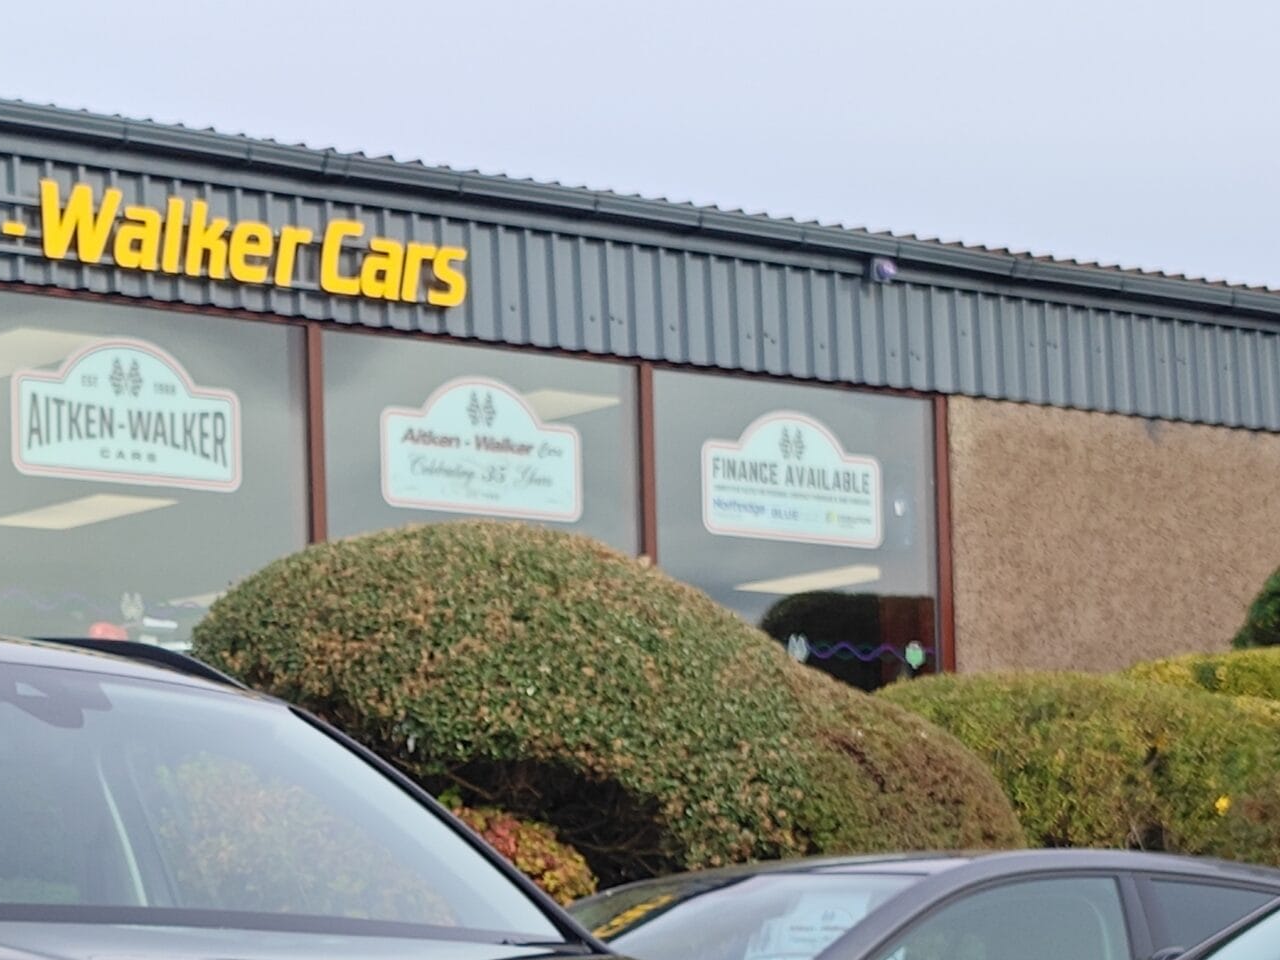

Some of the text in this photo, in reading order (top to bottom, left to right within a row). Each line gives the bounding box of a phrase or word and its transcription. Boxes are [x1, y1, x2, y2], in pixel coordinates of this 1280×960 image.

[42, 183, 309, 283] Walker
[321, 221, 464, 305] Cars
[26, 391, 228, 469] AITKEN-WALKER
[474, 434, 535, 455] Walker
[99, 449, 157, 463] CARS
[712, 457, 778, 486] FINANCE
[784, 465, 871, 495] AVAILABLE
